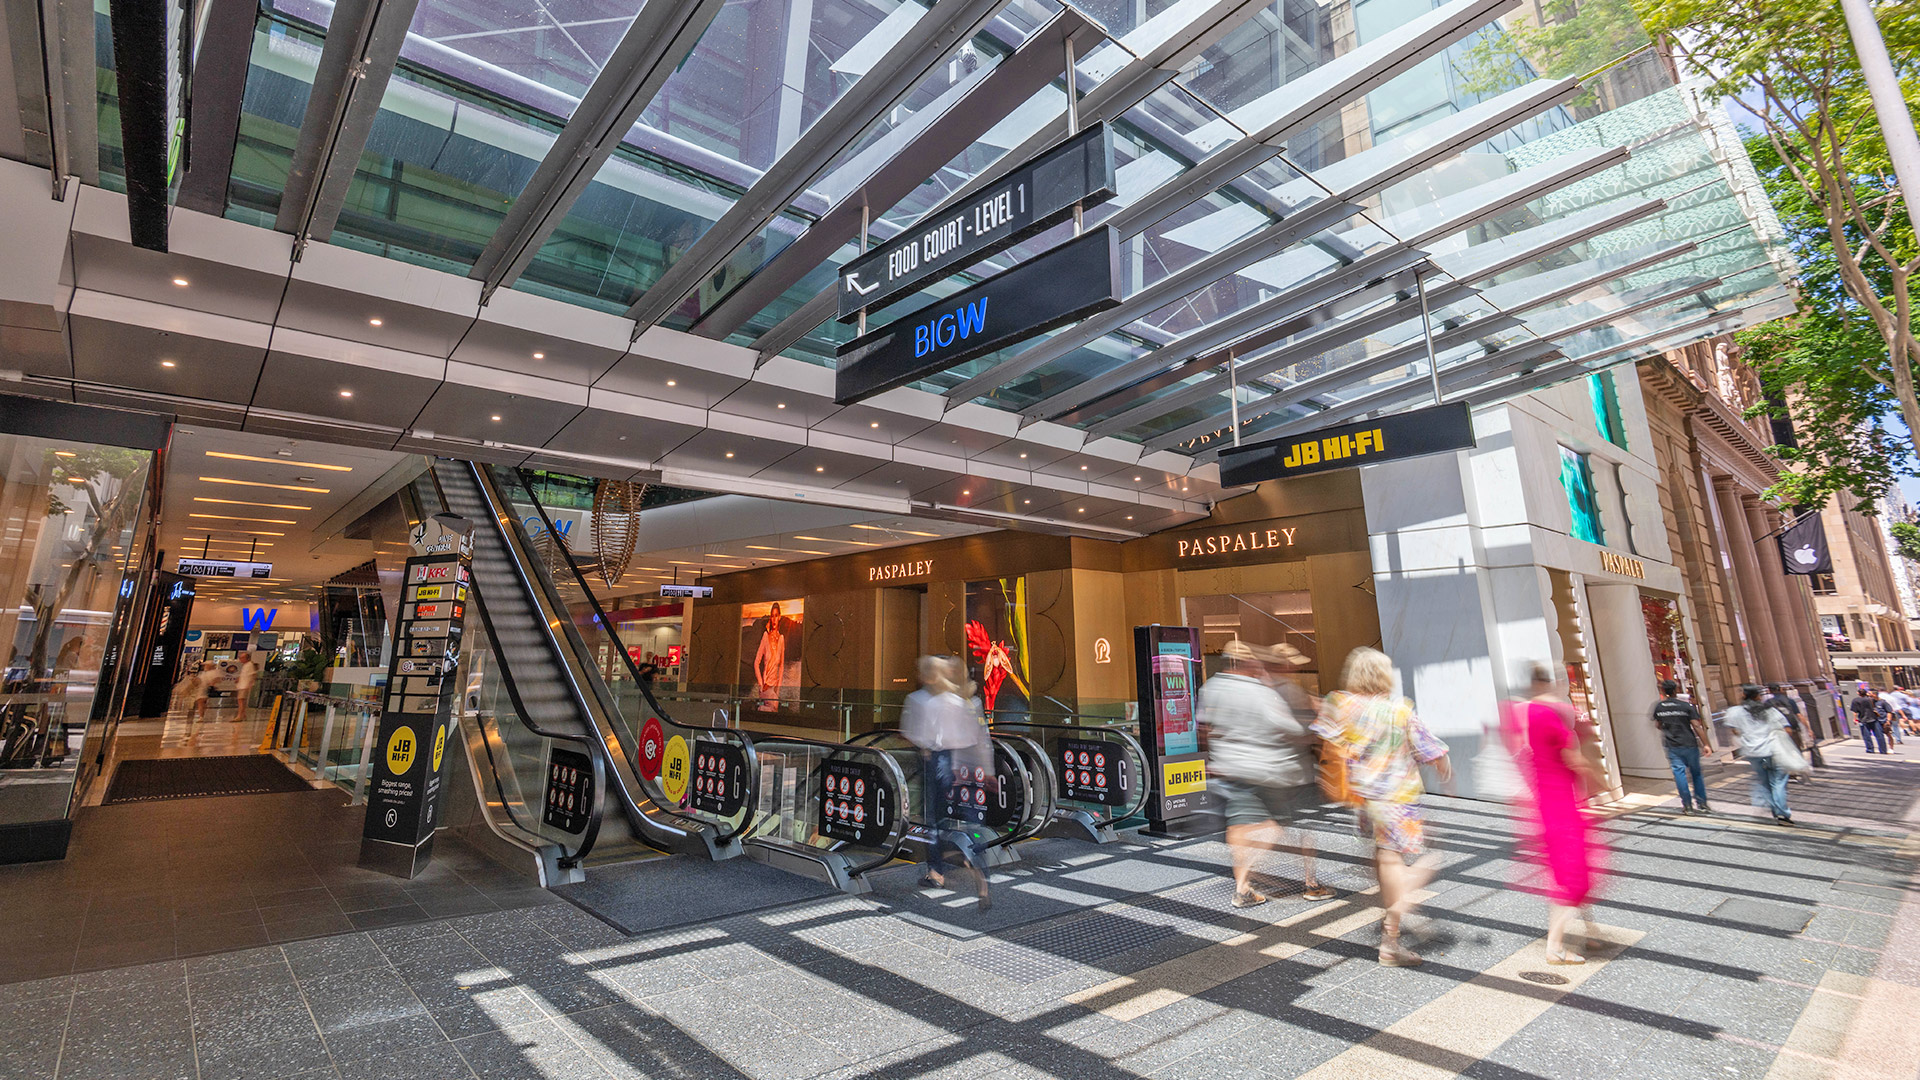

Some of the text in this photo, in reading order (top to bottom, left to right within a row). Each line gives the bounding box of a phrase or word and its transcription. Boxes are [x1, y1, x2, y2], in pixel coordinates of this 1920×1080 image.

[888, 241, 919, 281] FOOD
[923, 215, 964, 263] COURT
[975, 190, 1014, 236] LEVEL
[1017, 183, 1026, 214] 1
[1283, 440, 1321, 468] JB
[1178, 527, 1296, 557] PASPALEY
[428, 567, 449, 578] KFC
[869, 560, 933, 581] PASPALEY
[1600, 551, 1646, 579] PASPALEY
[242, 608, 278, 631] W
[1166, 677, 1186, 690] WIN
[394, 740, 411, 752] JB
[670, 757, 682, 771] JB
[1118, 760, 1127, 790] G
[733, 765, 741, 799] G
[997, 774, 1007, 809] G
[1168, 772, 1182, 785] JB
[876, 787, 886, 827] G
